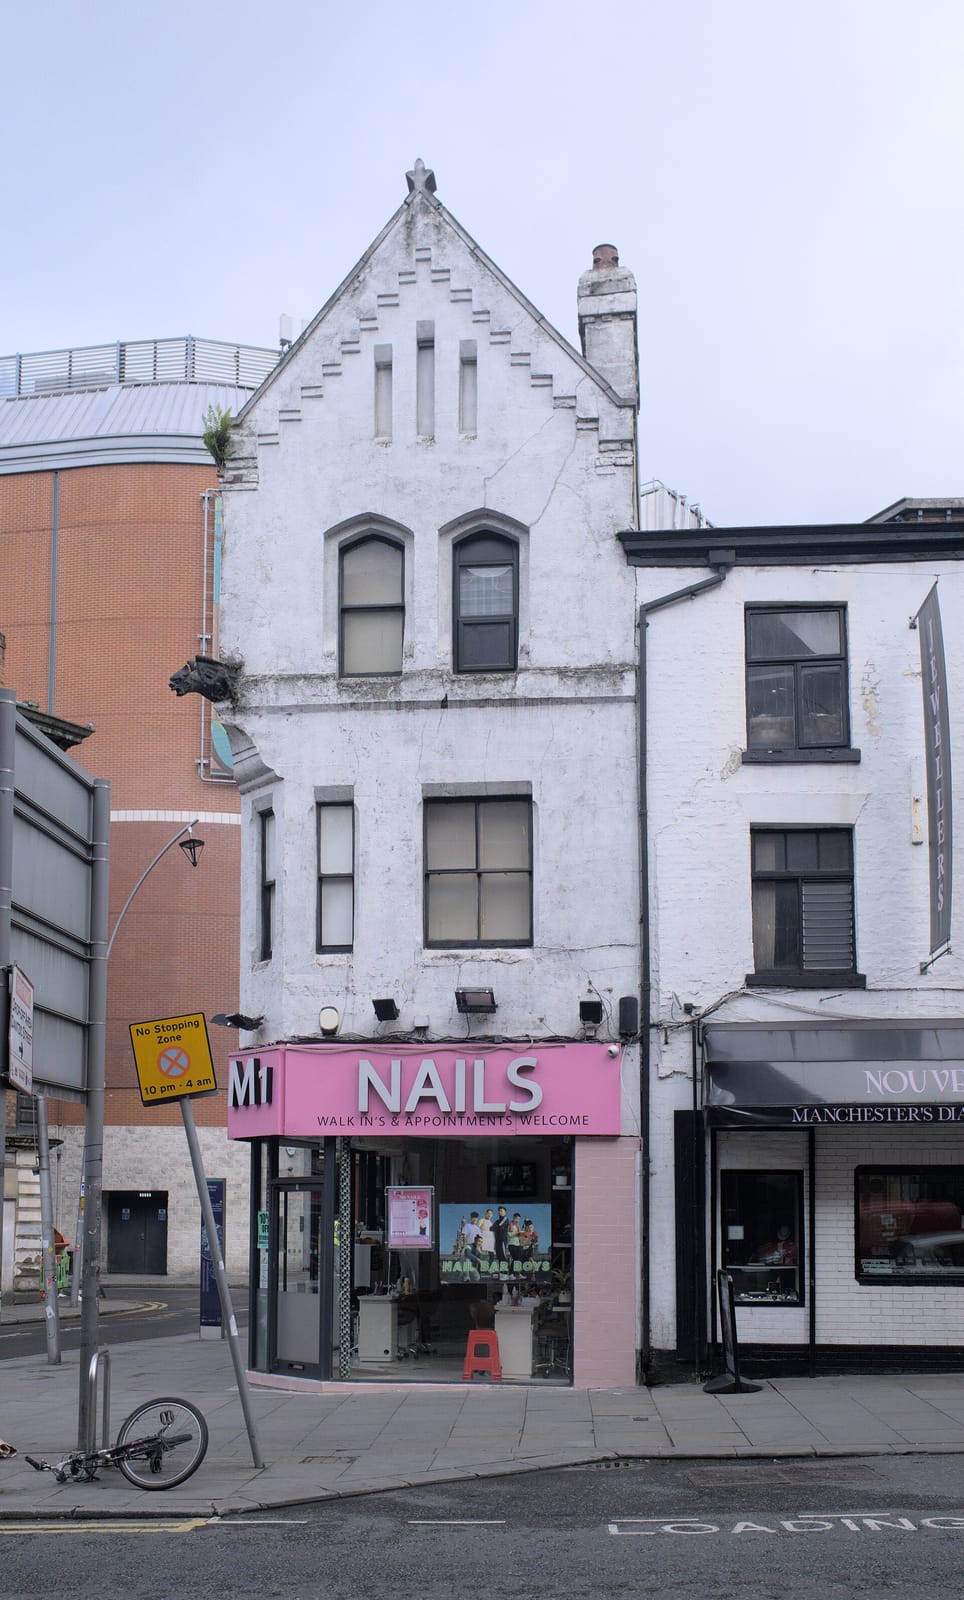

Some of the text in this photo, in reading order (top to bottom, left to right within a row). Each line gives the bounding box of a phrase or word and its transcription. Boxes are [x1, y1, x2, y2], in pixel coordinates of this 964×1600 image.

[927, 617, 945, 912] JEWELLERS
[136, 1020, 200, 1037] No Stopping
[157, 1034, 182, 1044] Zone
[144, 1085, 157, 1096] 10
[160, 1083, 176, 1094] pm
[185, 1079, 193, 1088] 4
[196, 1077, 212, 1087] am
[229, 1058, 273, 1108] M1
[358, 1057, 544, 1113] NAILS
[317, 1115, 589, 1127] WALK IN'S & APPOINTMENTS WELCOME
[792, 1107, 934, 1122] MANCHESTER'S
[480, 1260, 509, 1273] BAR
[513, 1260, 550, 1273] BOYS
[608, 1517, 964, 1535] LOADING
